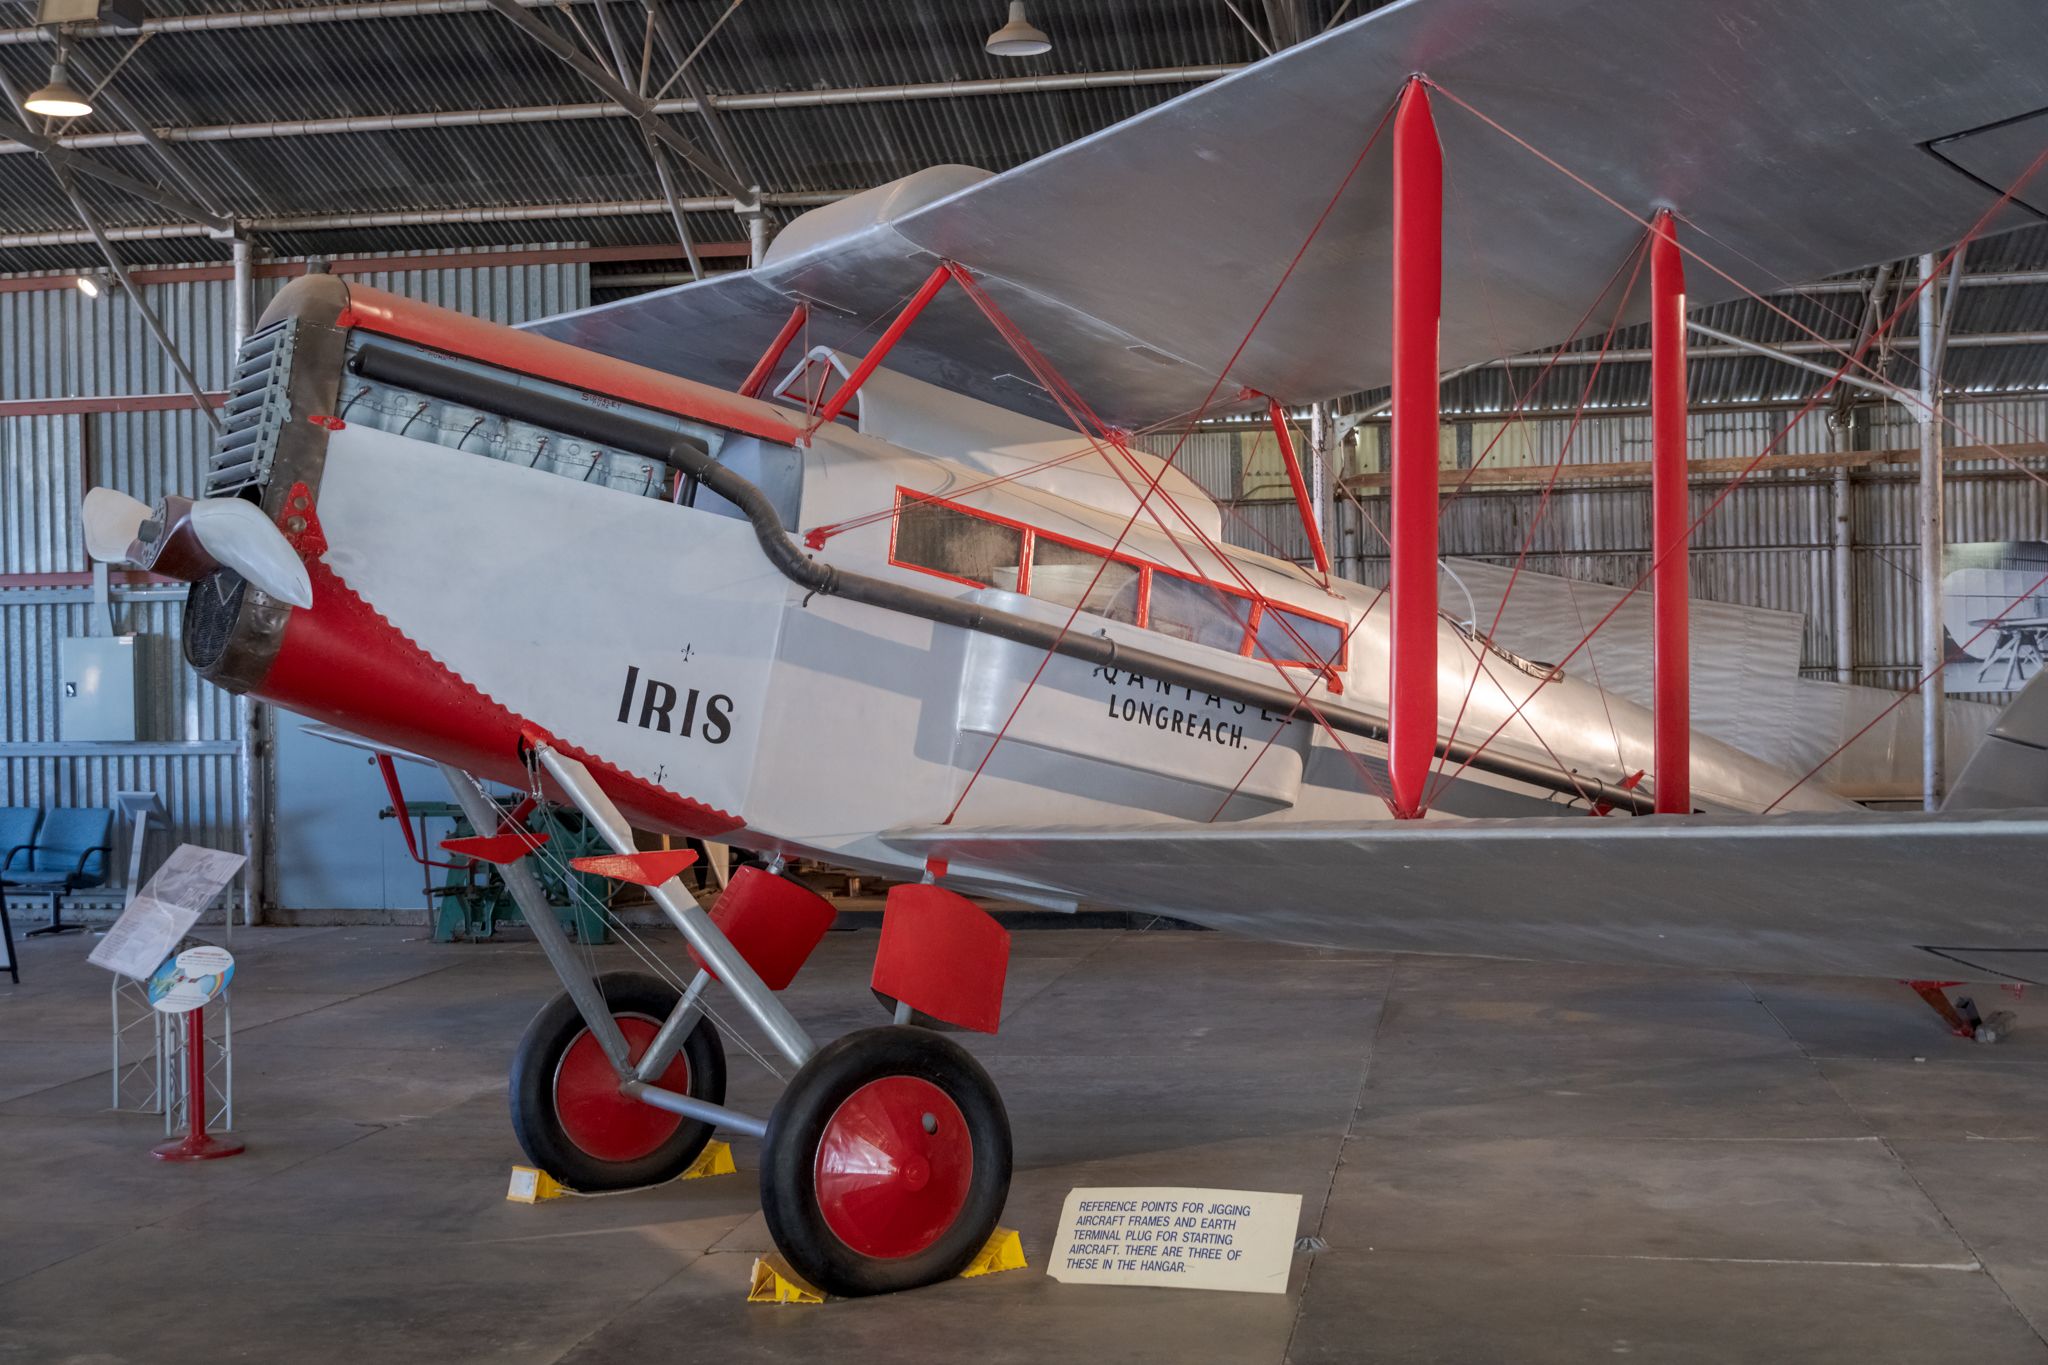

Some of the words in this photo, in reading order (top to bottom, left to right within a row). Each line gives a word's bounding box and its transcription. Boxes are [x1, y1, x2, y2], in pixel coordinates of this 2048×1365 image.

[617, 665, 734, 744] IRIS
[1108, 694, 1248, 750] LONGREACH.
[1079, 1201, 1137, 1212] REFERENCE
[1141, 1202, 1178, 1212] POINTS
[1182, 1203, 1204, 1213] FOR
[1208, 1204, 1250, 1216] JIGGING
[1076, 1216, 1125, 1226] AIRCRAFT
[1128, 1216, 1170, 1226] FRAMES
[1174, 1217, 1197, 1228] AND
[1201, 1218, 1236, 1230] EARTH
[1073, 1230, 1121, 1240] TERMINAL
[1125, 1231, 1152, 1241] PLUG
[1156, 1231, 1177, 1242] FOR
[1182, 1232, 1233, 1245] STARTING
[1069, 1244, 1120, 1255] AIRCRAFT.
[1125, 1245, 1157, 1256] THERE
[1161, 1246, 1183, 1257] ARE
[1188, 1248, 1222, 1260] THREE
[1227, 1250, 1242, 1261] OF
[1066, 1258, 1098, 1269] THESE
[1103, 1259, 1112, 1269] IN
[1117, 1260, 1137, 1270] THE
[1140, 1261, 1186, 1272] HANGAR.
